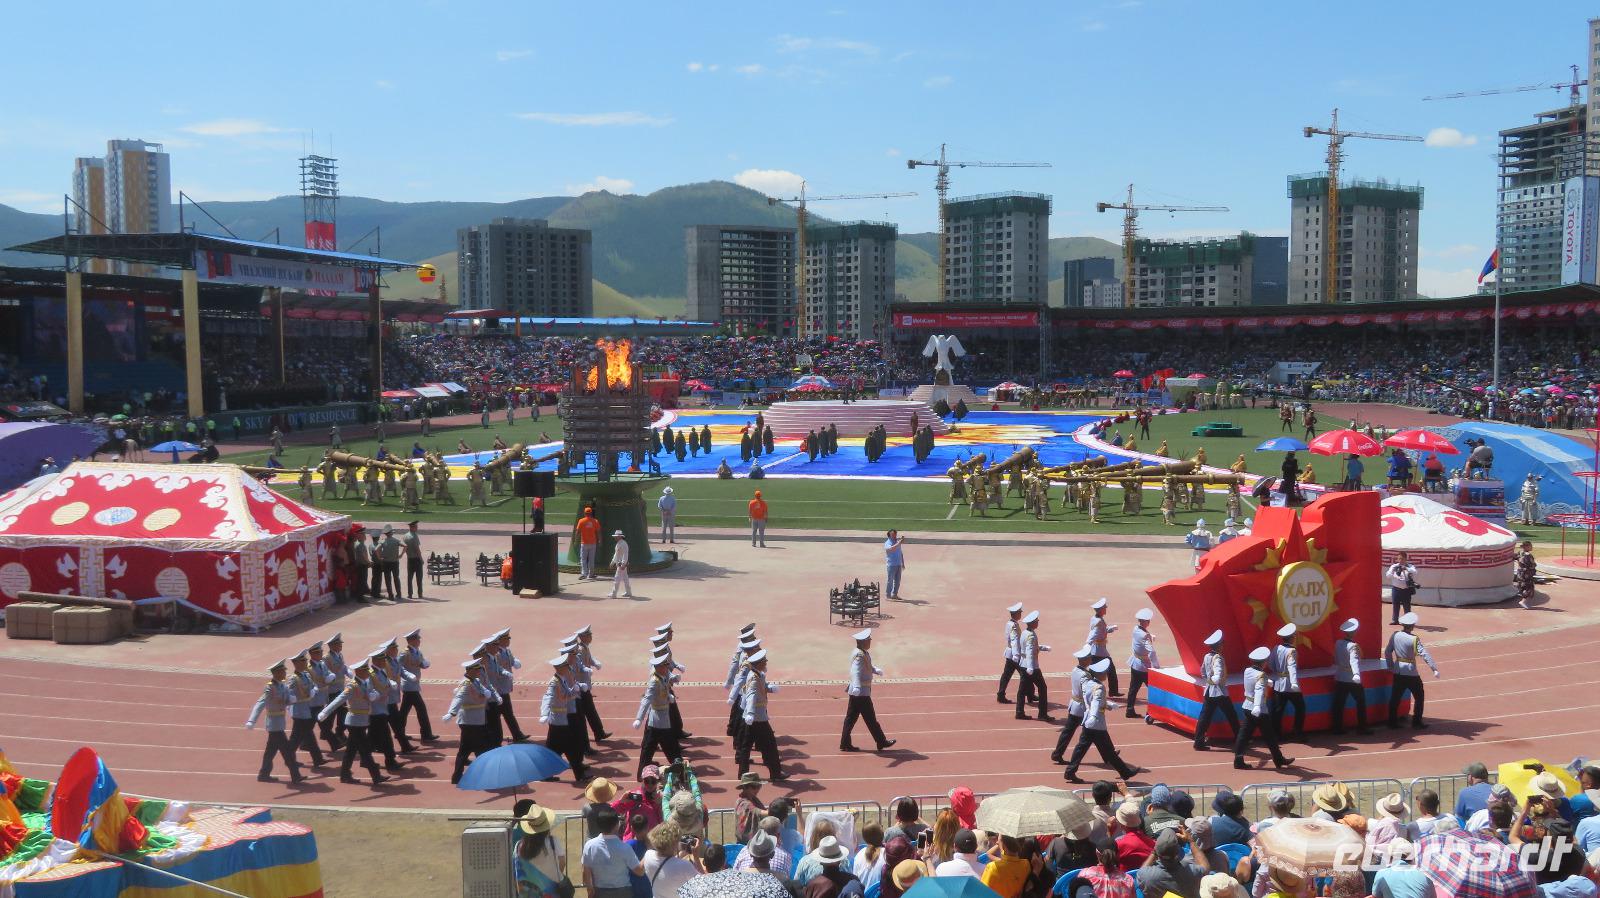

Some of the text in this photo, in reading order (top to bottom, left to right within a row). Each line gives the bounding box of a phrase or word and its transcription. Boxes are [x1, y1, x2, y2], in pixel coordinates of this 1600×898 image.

[1566, 211, 1575, 264] TOYOTA
[1584, 210, 1593, 263] TOYOTA
[244, 415, 263, 429] SKY
[309, 408, 357, 424] RESIDENCE
[1284, 581, 1326, 599] ХАЛХ
[1291, 601, 1321, 619] ГОЛ
